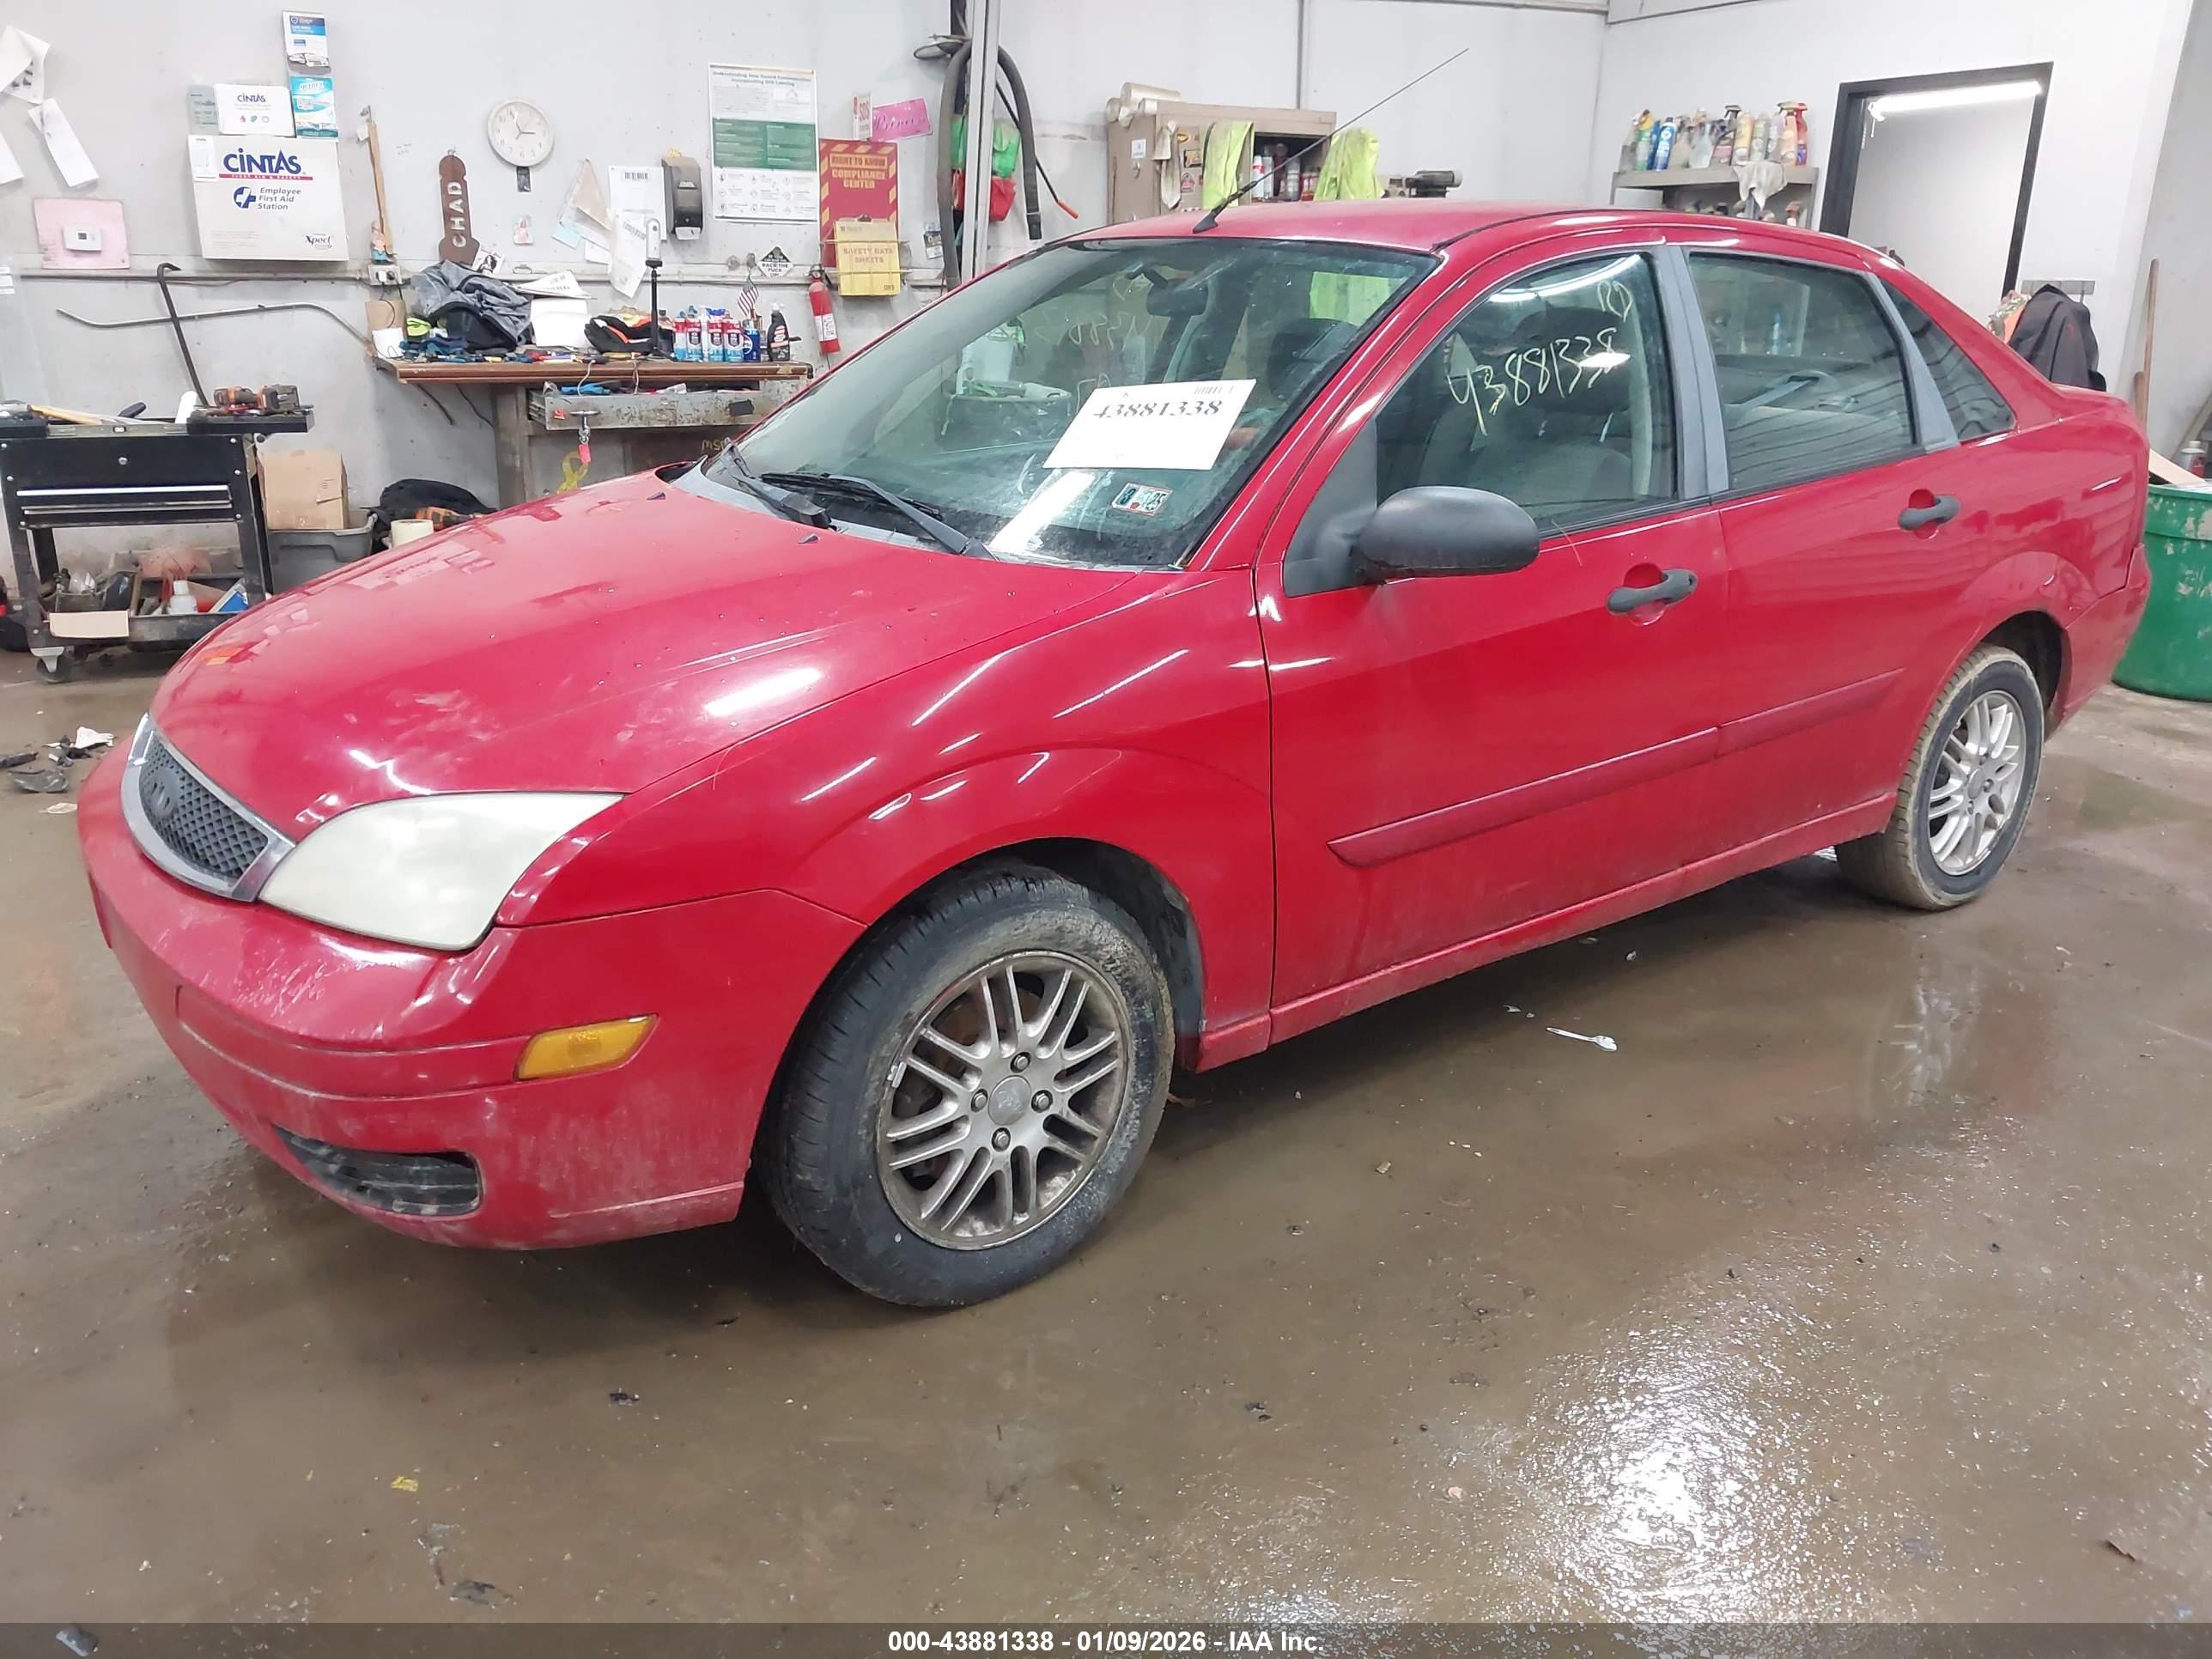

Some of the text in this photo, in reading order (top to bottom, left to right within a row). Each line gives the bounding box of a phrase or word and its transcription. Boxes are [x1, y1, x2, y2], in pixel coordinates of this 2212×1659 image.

[259, 187, 301, 196] Employee
[447, 181, 467, 247] CHAD
[1093, 399, 1223, 418] 43881338
